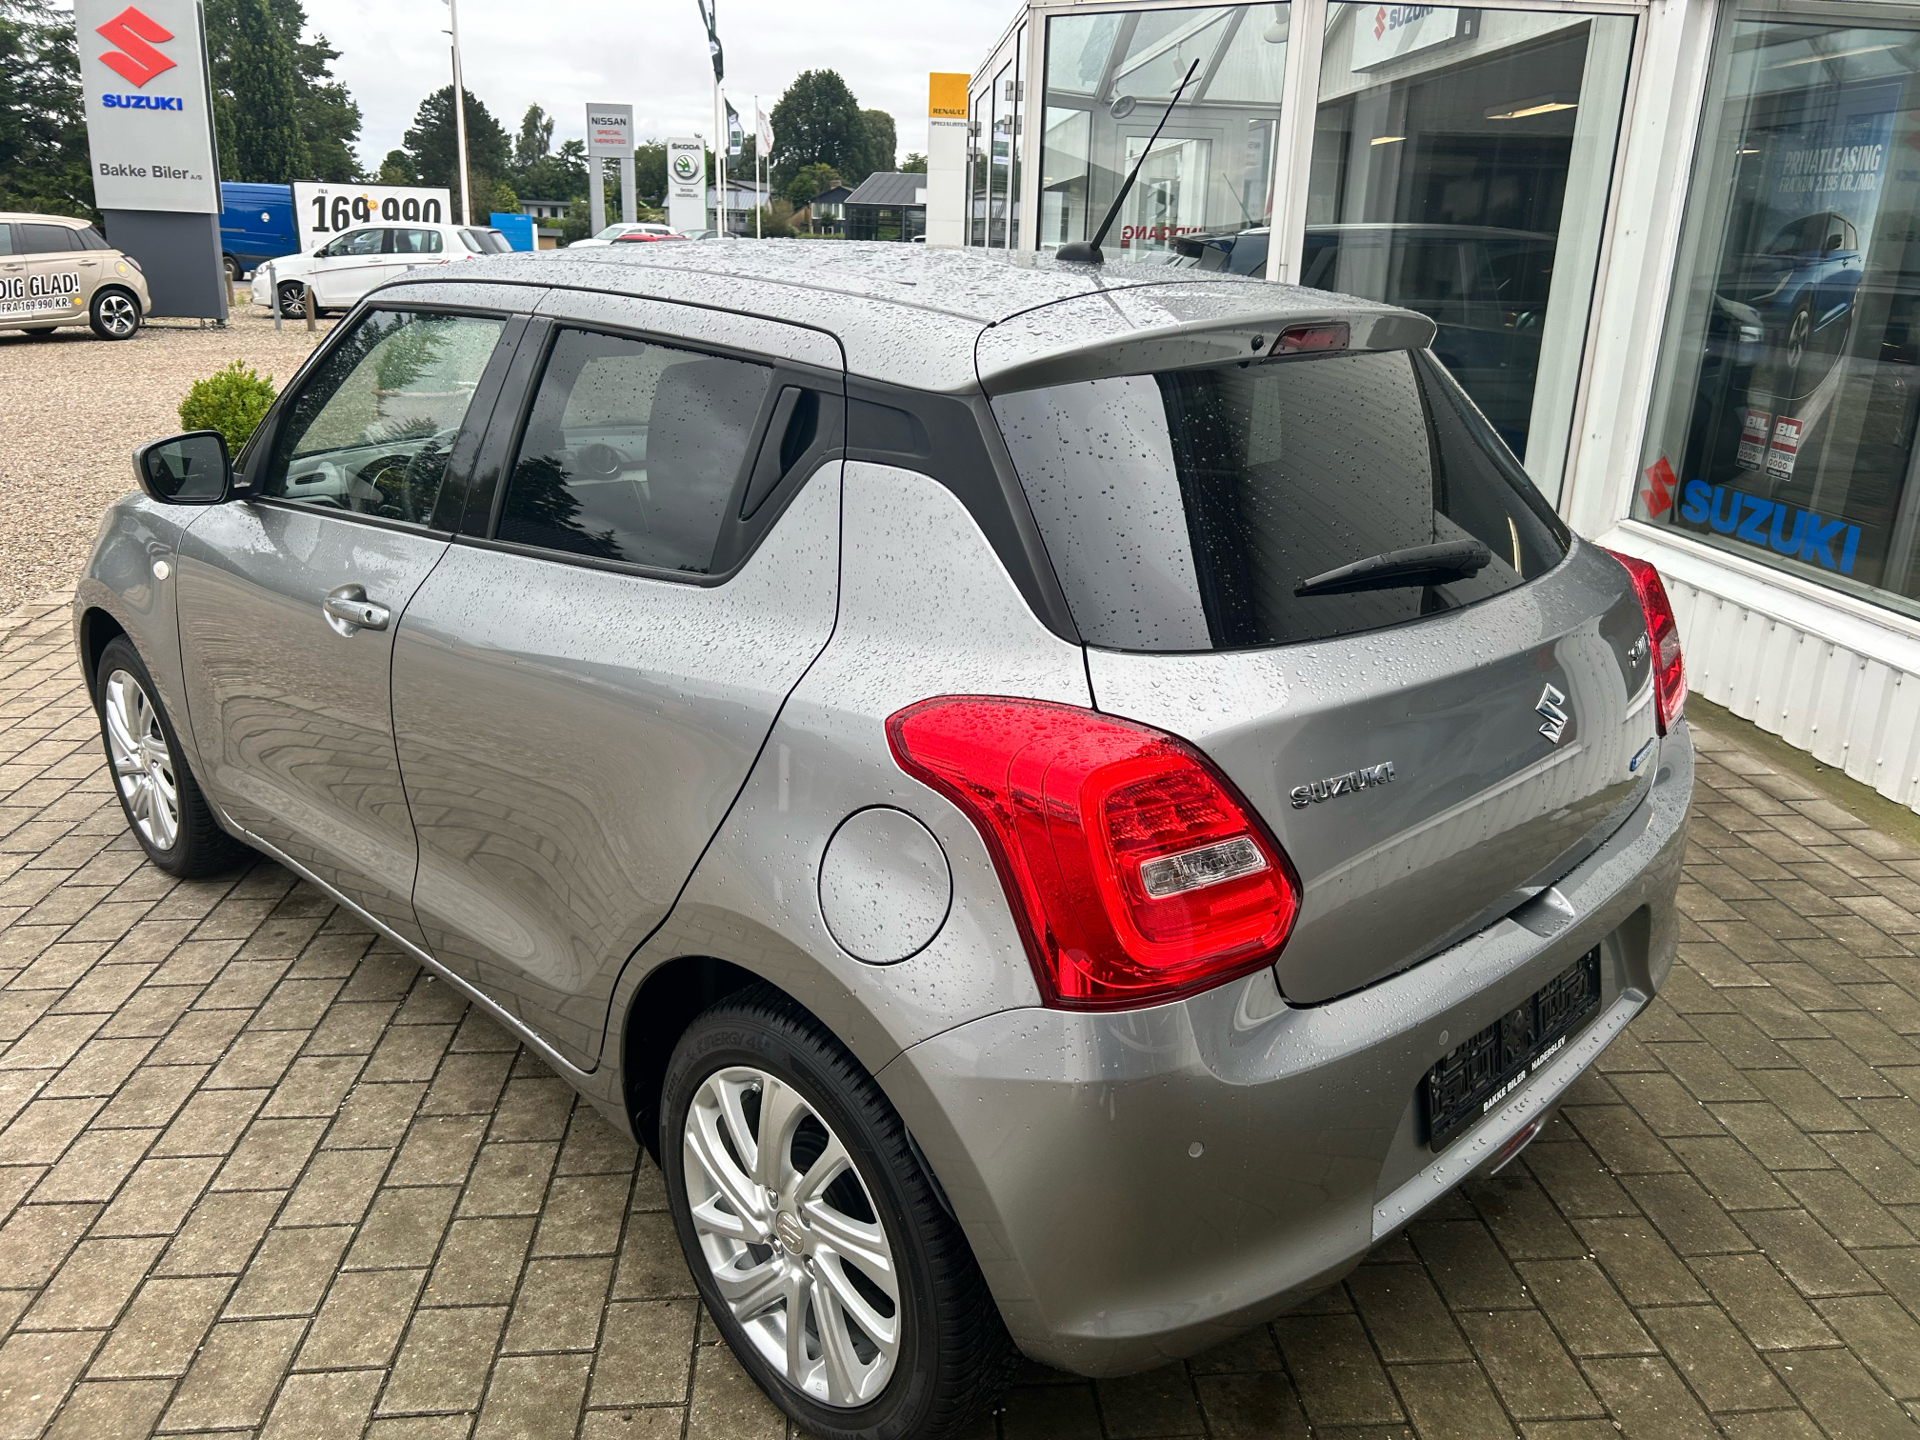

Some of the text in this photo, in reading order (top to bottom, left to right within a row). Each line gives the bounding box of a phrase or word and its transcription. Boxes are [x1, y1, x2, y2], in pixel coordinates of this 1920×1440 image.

[102, 94, 183, 111] SUZUKI
[591, 117, 626, 126] NISSAN
[1782, 144, 1882, 175] PRIVATLEASING
[99, 163, 146, 177] Bakke
[152, 166, 189, 179] Biler
[1780, 178, 1795, 192] FRA
[1815, 175, 1839, 192] 2.195
[30, 274, 79, 296] GLAD!
[2, 297, 70, 312] FRA 169.990 KR.
[1746, 415, 1768, 430] BIL
[1776, 423, 1799, 438] BIL
[1681, 479, 1861, 574] SUZUKI
[1290, 761, 1396, 809] SUZUKI
[1484, 1035, 1566, 1112] BAKKE BILER HADERSLEV
